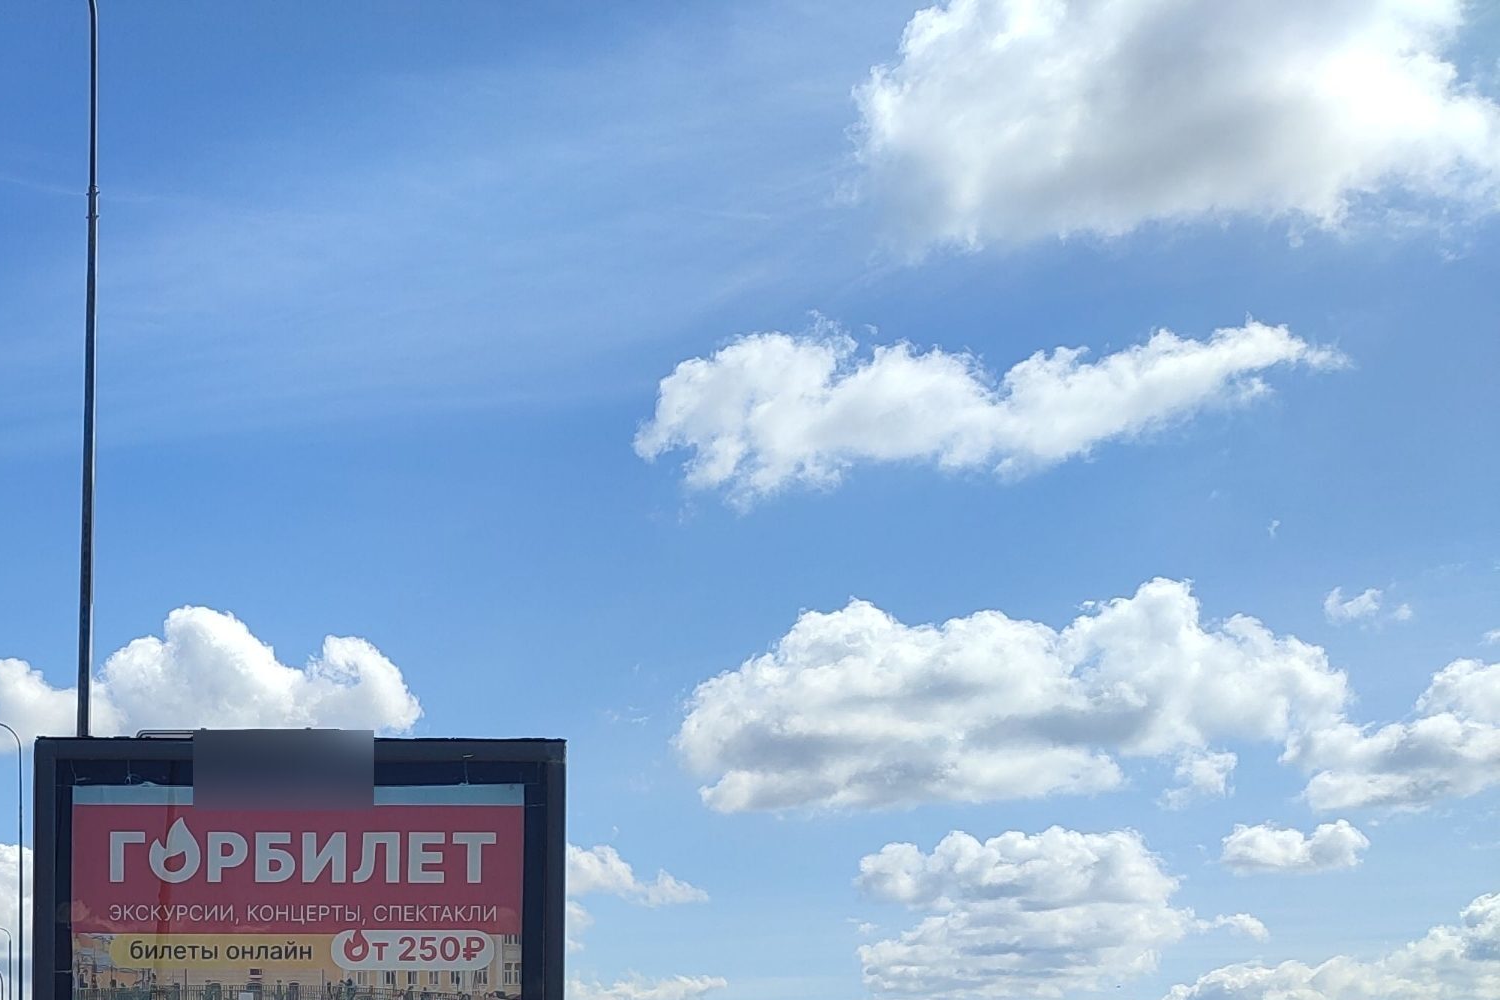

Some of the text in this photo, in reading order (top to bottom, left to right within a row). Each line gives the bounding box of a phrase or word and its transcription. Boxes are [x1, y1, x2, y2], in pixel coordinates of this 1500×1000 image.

[108, 817, 497, 883] ГОРБИЛЕТ
[108, 903, 498, 924] ЭКСКУРСИИ, КОНЦЕРТЫ, СПЕКТАКЛИ
[129, 940, 313, 961] билеты онлайн
[397, 936, 486, 962] 250₽
